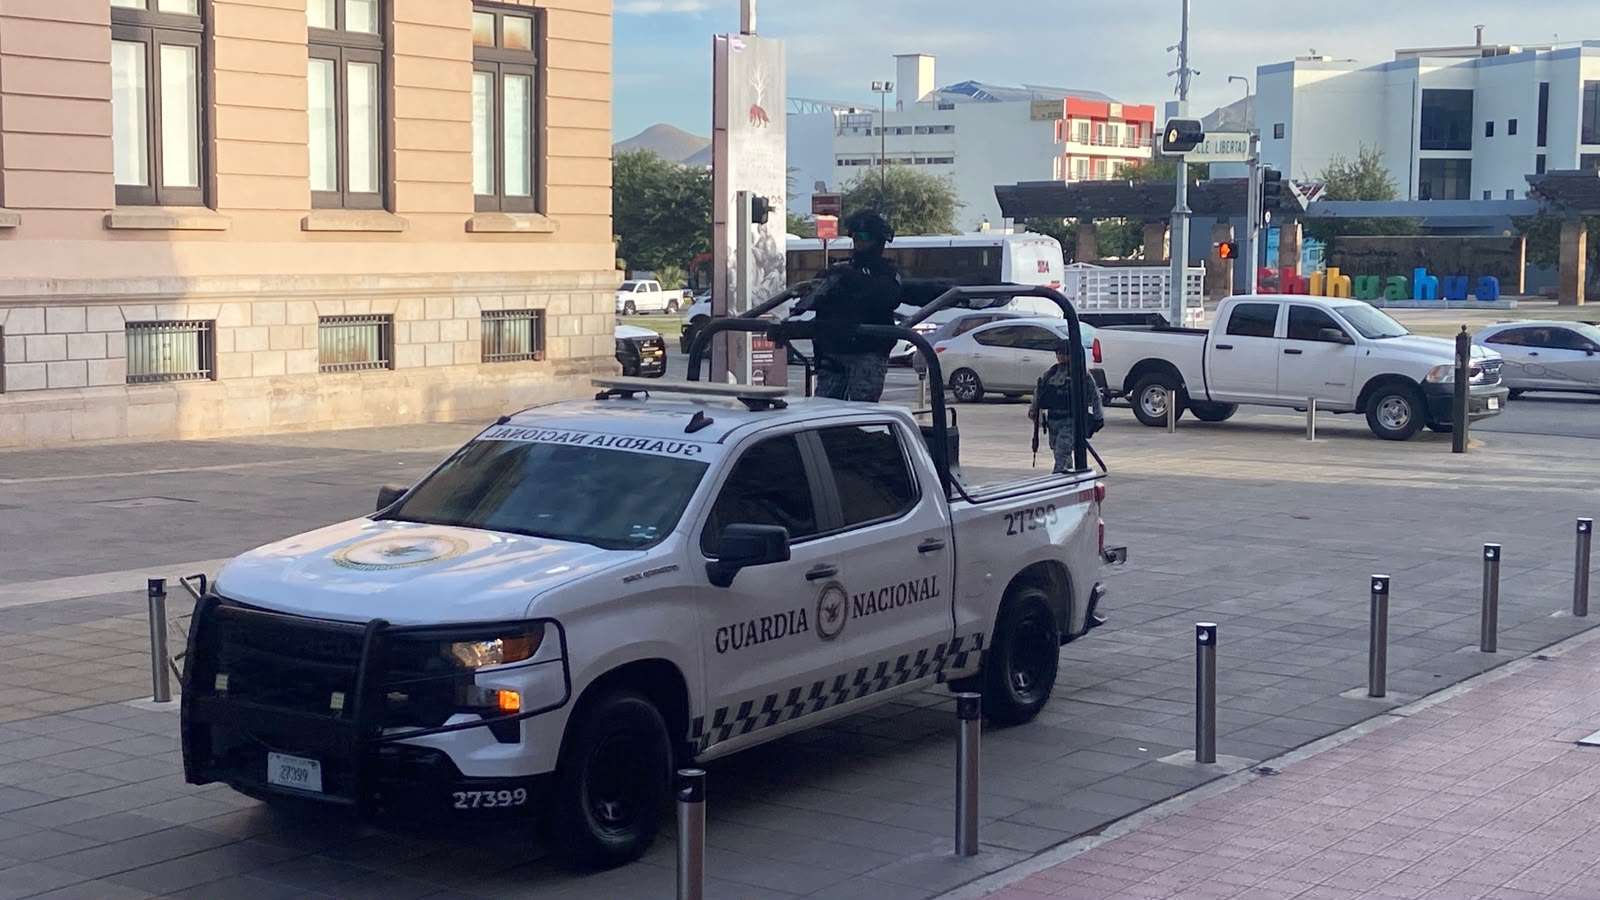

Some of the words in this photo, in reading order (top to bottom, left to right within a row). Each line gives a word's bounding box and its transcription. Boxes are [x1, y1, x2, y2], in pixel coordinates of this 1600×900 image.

[1215, 139, 1247, 154] LIBERTAD
[1004, 503, 1057, 536] 27399
[715, 607, 809, 655] GUARDIA
[851, 574, 941, 619] NACIONAL
[452, 788, 527, 809] 27399
